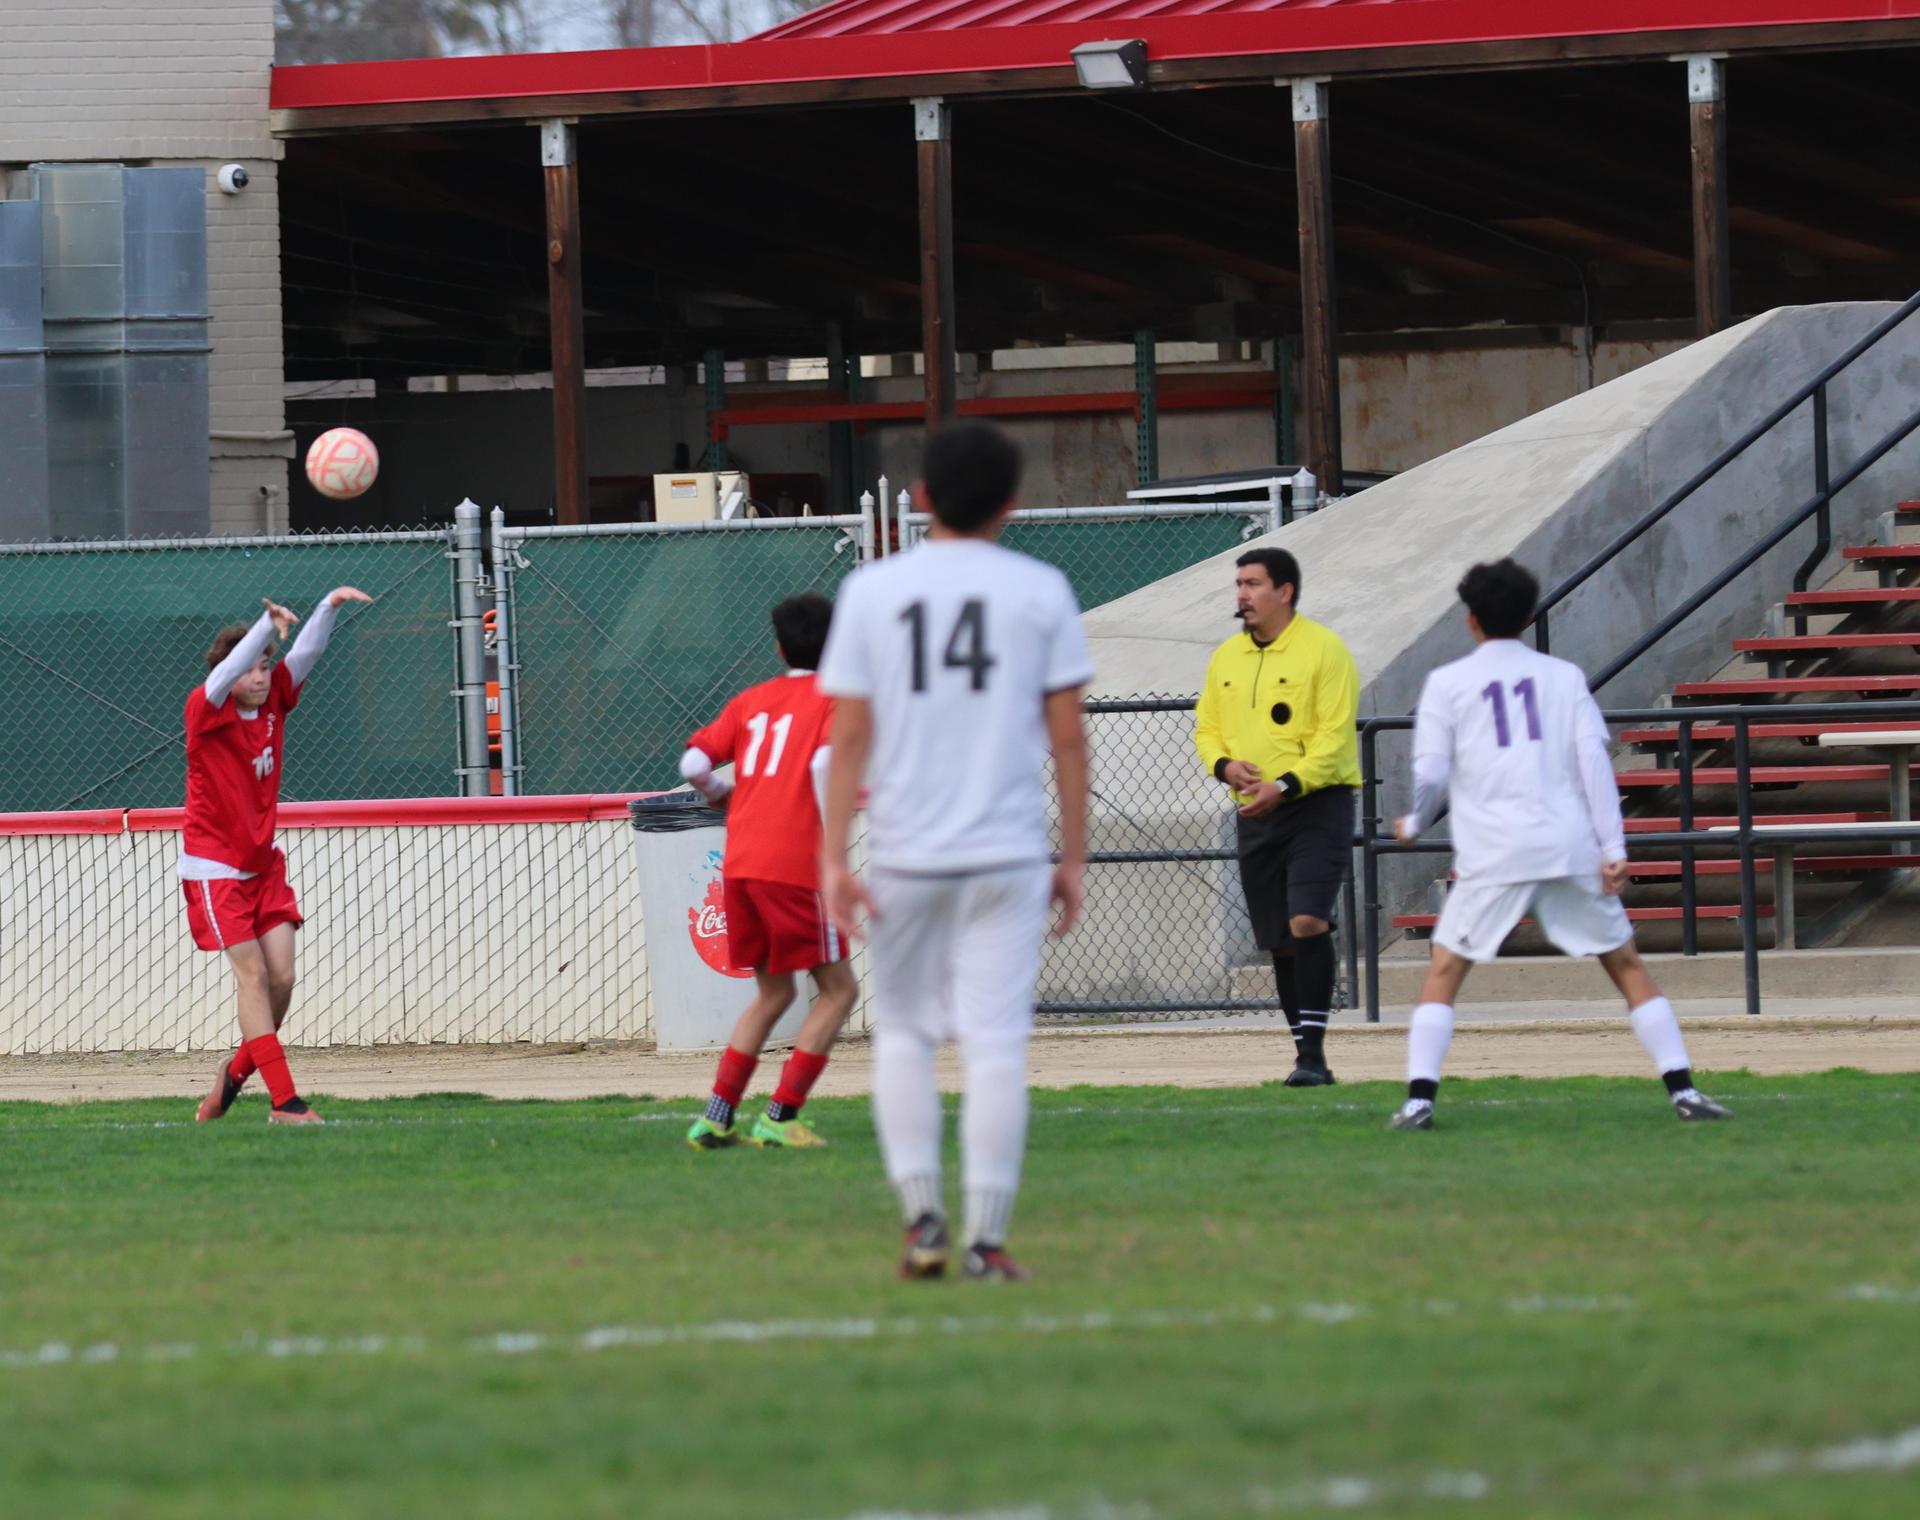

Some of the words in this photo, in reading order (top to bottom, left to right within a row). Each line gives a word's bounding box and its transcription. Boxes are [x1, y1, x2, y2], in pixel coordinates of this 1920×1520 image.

[900, 601, 995, 692] 14
[743, 712, 793, 777] 11
[1482, 677, 1542, 747] 11
